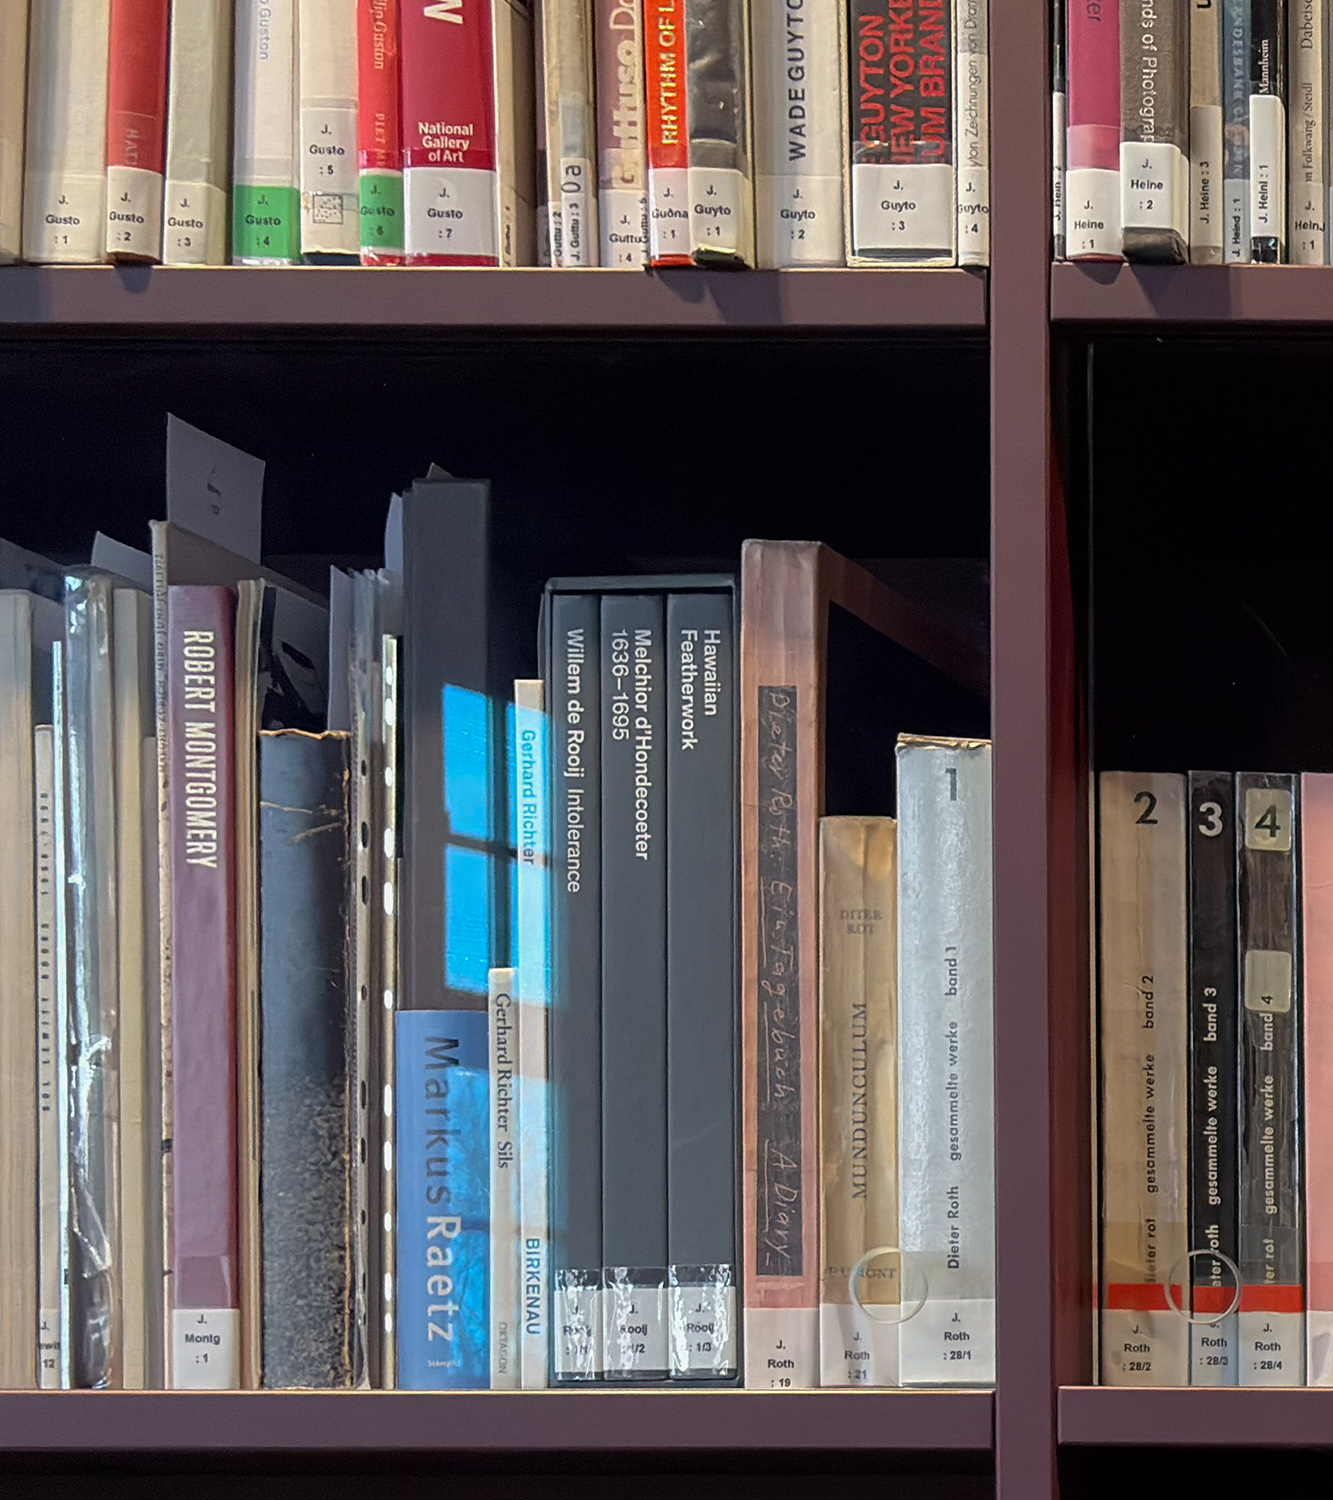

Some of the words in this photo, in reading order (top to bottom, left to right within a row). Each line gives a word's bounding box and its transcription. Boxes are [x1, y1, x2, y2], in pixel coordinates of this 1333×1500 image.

[418, 122, 473, 136] National
[422, 136, 469, 151] Gallery
[428, 150, 439, 162] of
[440, 151, 464, 163] Art
[881, 200, 916, 212] Guyto
[1131, 179, 1164, 190] Heine
[427, 208, 463, 219] Gusto
[184, 631, 214, 713] ROBERT
[567, 629, 584, 694] Willem
[634, 629, 651, 704] Melchior
[682, 629, 698, 750] Featherwork
[704, 629, 721, 716] Hawaiian
[568, 700, 581, 724] de
[564, 728, 584, 778] Rooij
[185, 722, 217, 868] MONTGOMERY
[635, 709, 652, 860] d'Hondecoeter
[1132, 791, 1159, 826] 2
[567, 788, 584, 893] Intolerance
[945, 958, 958, 996] band
[948, 1021, 958, 1067] werke
[425, 1036, 460, 1206] Markus
[853, 1002, 868, 1200] MUNDUNCULUM
[948, 1073, 962, 1161] gesammelte
[948, 1186, 959, 1216] Roth
[948, 1220, 959, 1269] Dieter
[427, 1216, 462, 1342] Raetz
[526, 1238, 541, 1335] BIRKENAU
